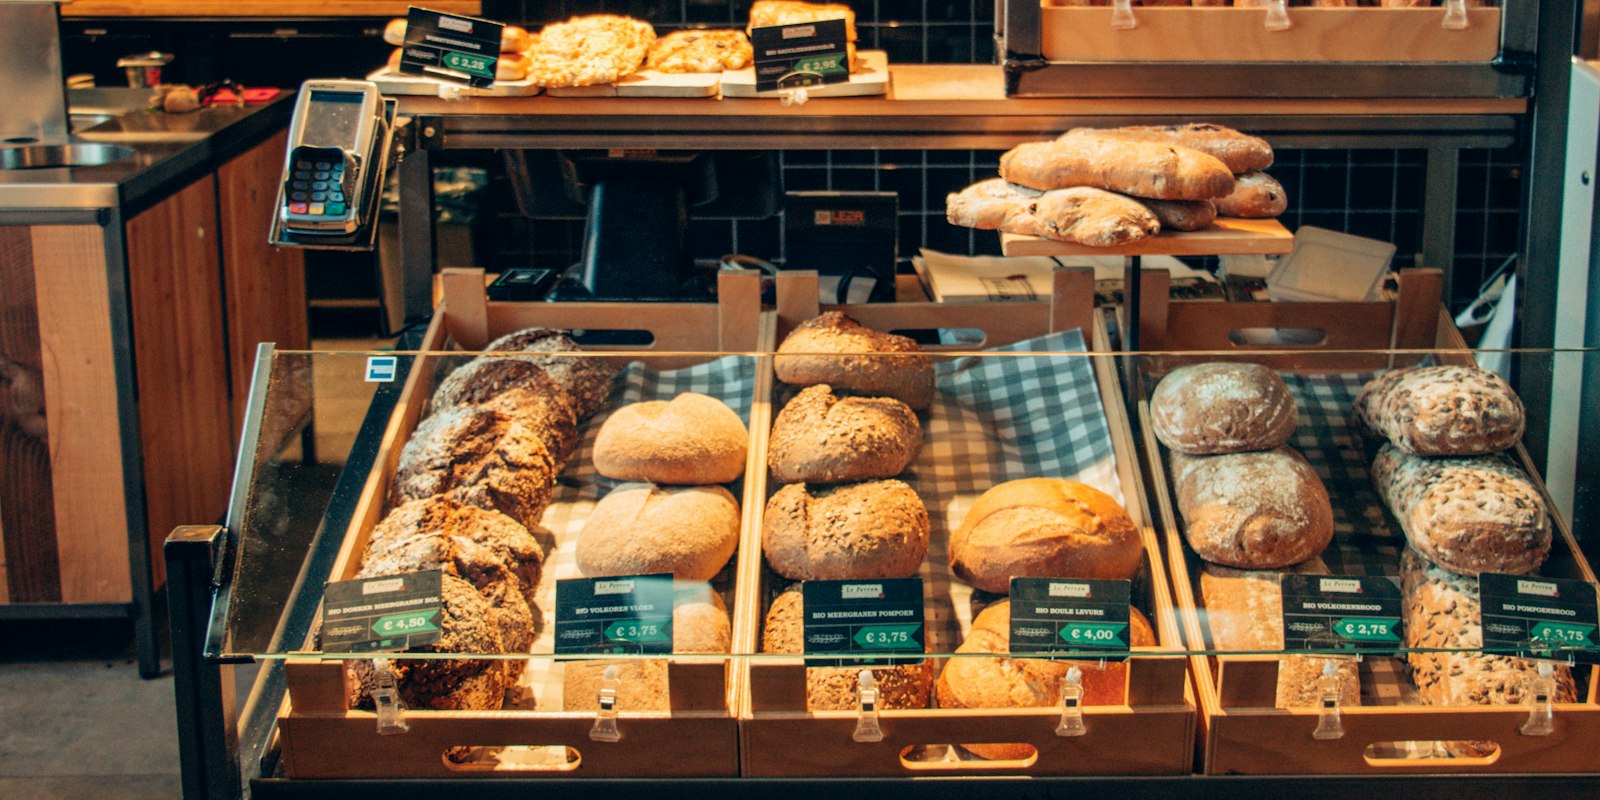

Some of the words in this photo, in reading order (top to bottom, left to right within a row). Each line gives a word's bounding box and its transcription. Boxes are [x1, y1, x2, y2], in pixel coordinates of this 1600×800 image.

[451, 56, 460, 65] €
[461, 58, 485, 70] 2,25
[803, 63, 810, 71] €
[813, 60, 837, 71] 2,95
[342, 604, 373, 613] DONKER
[374, 599, 424, 610] MEERGRANEN
[590, 606, 628, 614] VOLKOREN
[630, 604, 654, 612] VLOER
[1317, 603, 1382, 611] VOLKORENBROOD
[1517, 605, 1576, 616] POMPOENBROOD
[827, 611, 877, 619] MEERGRANEN
[1075, 608, 1104, 616] LEVURE
[383, 621, 393, 630] €
[396, 617, 425, 630] 4,50
[616, 627, 625, 637] €
[629, 625, 657, 637] 3,75
[1071, 629, 1080, 638] €
[1084, 630, 1113, 640] 4,00
[1346, 624, 1354, 633] €
[1358, 625, 1387, 636] 2,75
[1555, 629, 1584, 641] 3,75
[865, 633, 875, 643] €
[879, 632, 907, 644] 3,75
